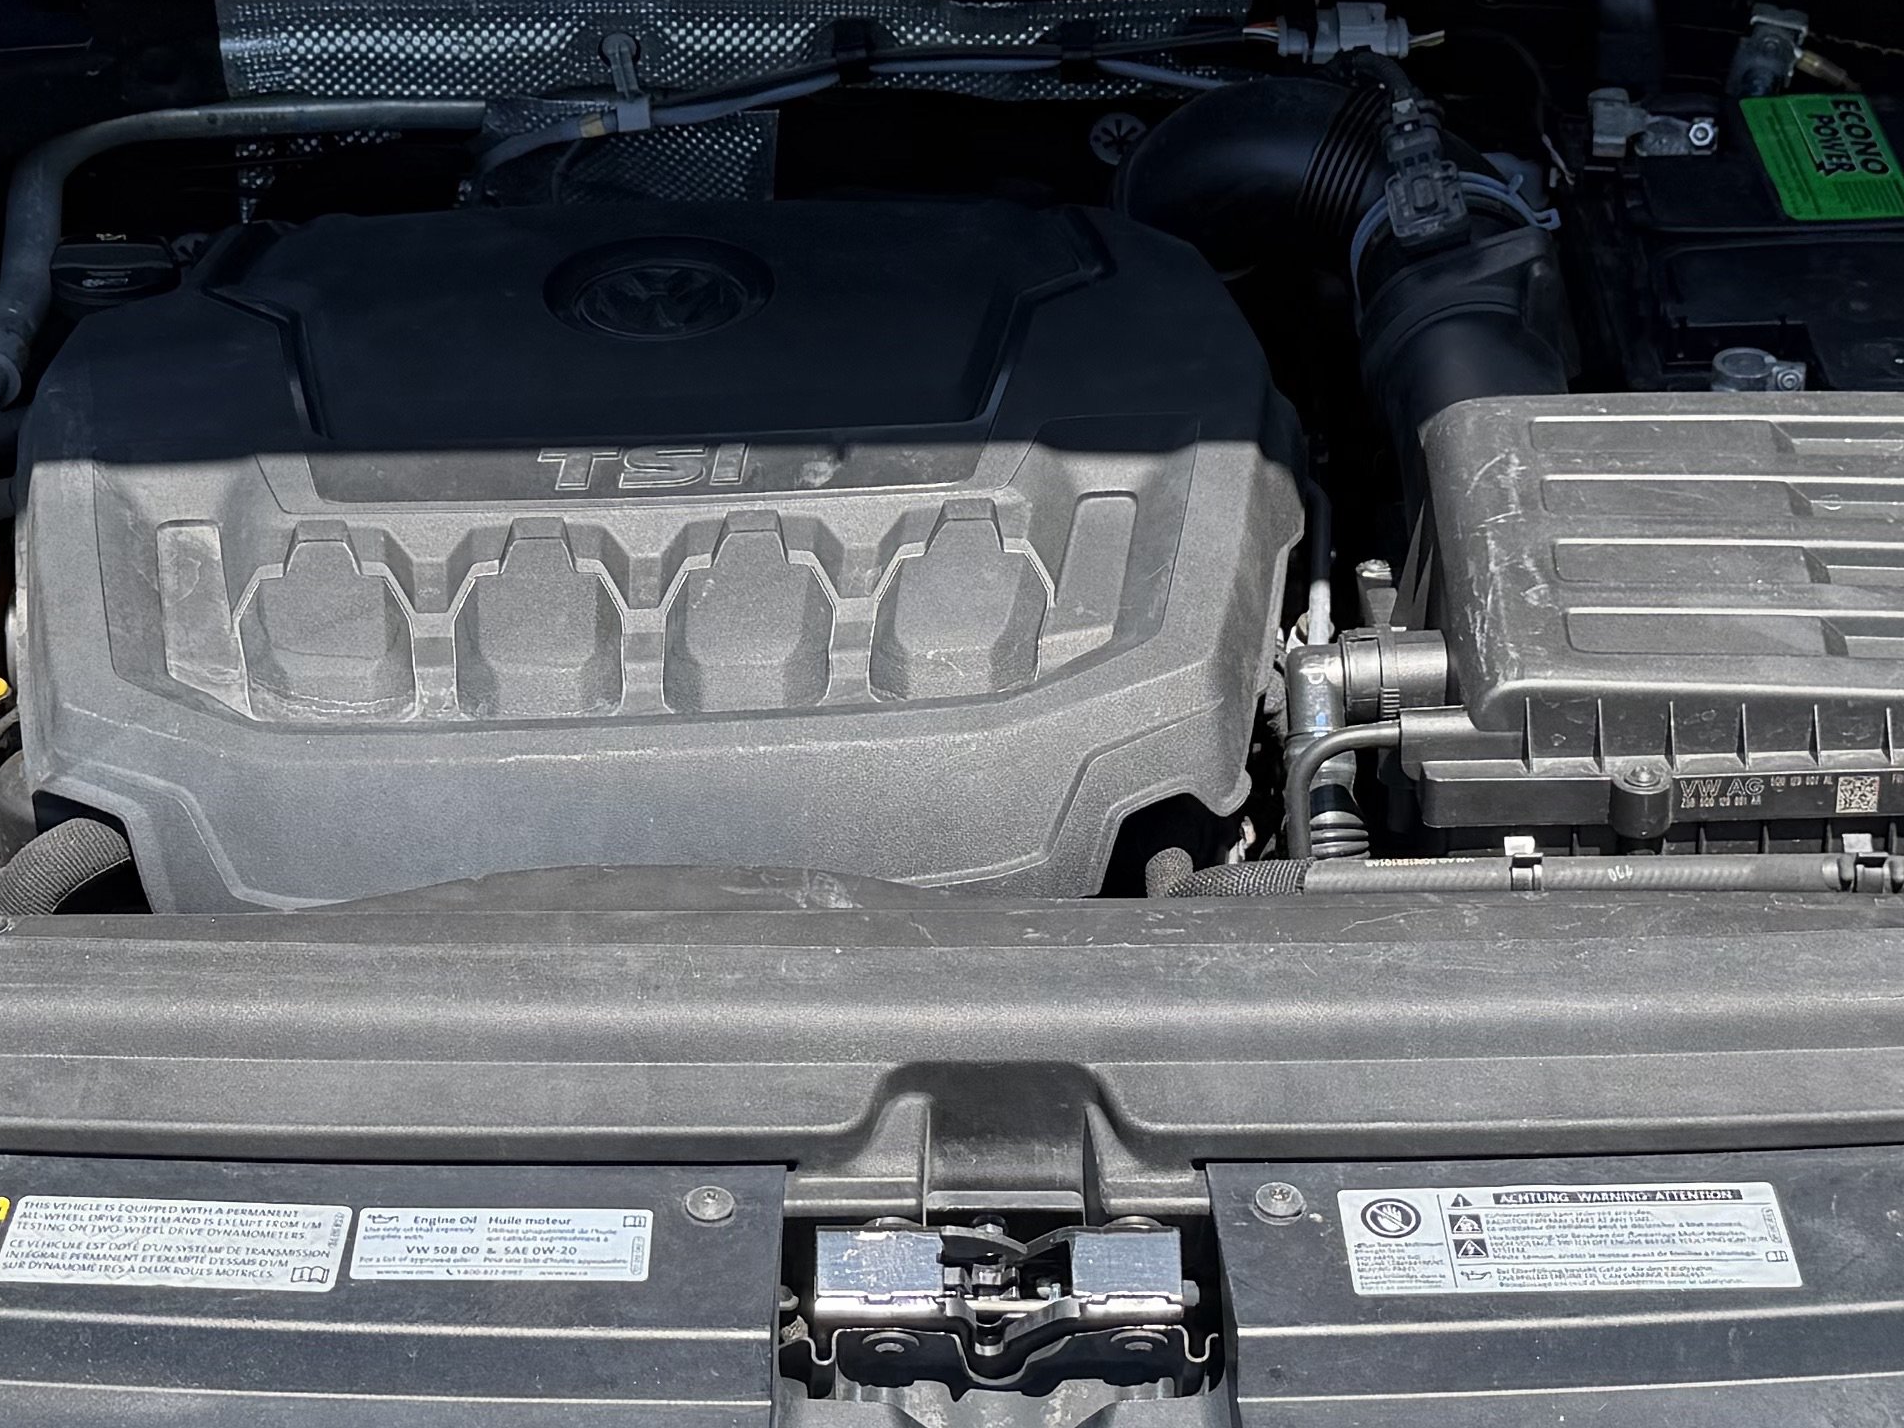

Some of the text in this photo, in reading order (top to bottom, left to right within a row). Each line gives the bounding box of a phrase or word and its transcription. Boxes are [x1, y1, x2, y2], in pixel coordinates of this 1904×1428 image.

[1807, 112, 1857, 174] POWER
[1830, 99, 1891, 175] ECONO
[537, 443, 750, 490] TSI
[1680, 777, 1765, 798] VW AG
[1500, 1189, 1733, 1203] ACHTUNG WARNING ATTENTION
[24, 1201, 50, 1210] THIS
[53, 1202, 100, 1211] VEHICLE
[118, 1204, 177, 1213] EQUIPPED
[180, 1206, 213, 1215] WITH
[215, 1207, 224, 1215] A
[226, 1208, 299, 1218] PERMANENT
[20, 1211, 85, 1221] ALL-WHEEL
[88, 1213, 123, 1223] DRIVE
[127, 1215, 171, 1224] SYSTEM
[173, 1216, 201, 1225] AND
[204, 1217, 214, 1225] IS
[217, 1218, 262, 1227] EXEMPT
[265, 1219, 299, 1228] FROM
[414, 1215, 477, 1226] Engine Oil
[489, 1216, 572, 1226] Huile moteur
[17, 1222, 65, 1232] TESTING
[69, 1224, 88, 1232] ON
[90, 1225, 164, 1235] TWO-WHEEL
[168, 1226, 204, 1236] DRIVE
[10, 1239, 23, 1248] CE
[86, 1240, 106, 1250] EST
[226, 1246, 242, 1254] DE
[245, 1247, 330, 1259] TRANSMISSION
[406, 1245, 430, 1254] VW
[433, 1245, 458, 1254] 508
[461, 1246, 479, 1254] 00
[504, 1246, 529, 1255] SAE
[532, 1246, 577, 1255] 0W-20
[69, 1252, 139, 1262] PERMANENT
[142, 1254, 154, 1263] ET
[1, 1260, 26, 1270] SUR
[139, 1265, 170, 1274] DEUX
[173, 1266, 213, 1276] ROUES
